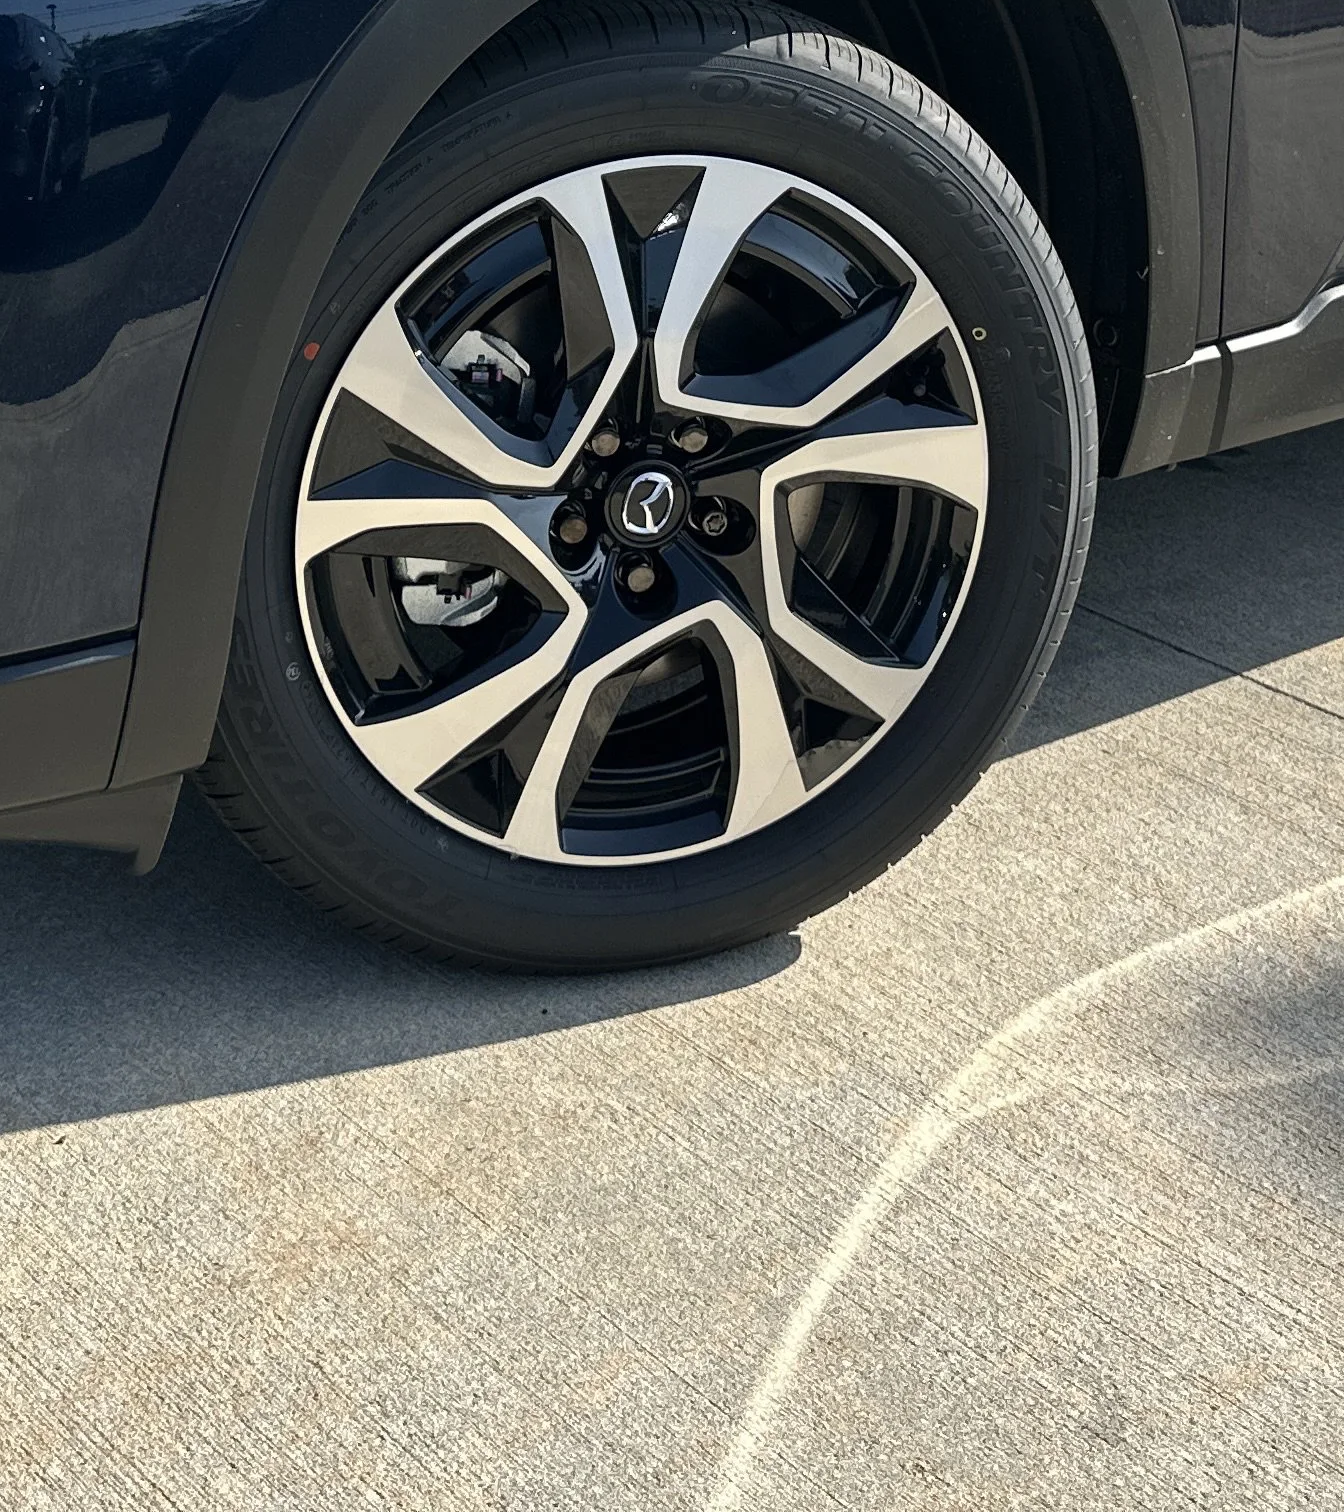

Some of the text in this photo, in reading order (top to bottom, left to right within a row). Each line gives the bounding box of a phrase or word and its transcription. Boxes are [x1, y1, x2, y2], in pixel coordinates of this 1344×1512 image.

[699, 74, 887, 141] OPEN
[904, 151, 1064, 416] COUNTRY
[1031, 461, 1066, 595] H/T
[306, 809, 464, 927] TOYO
